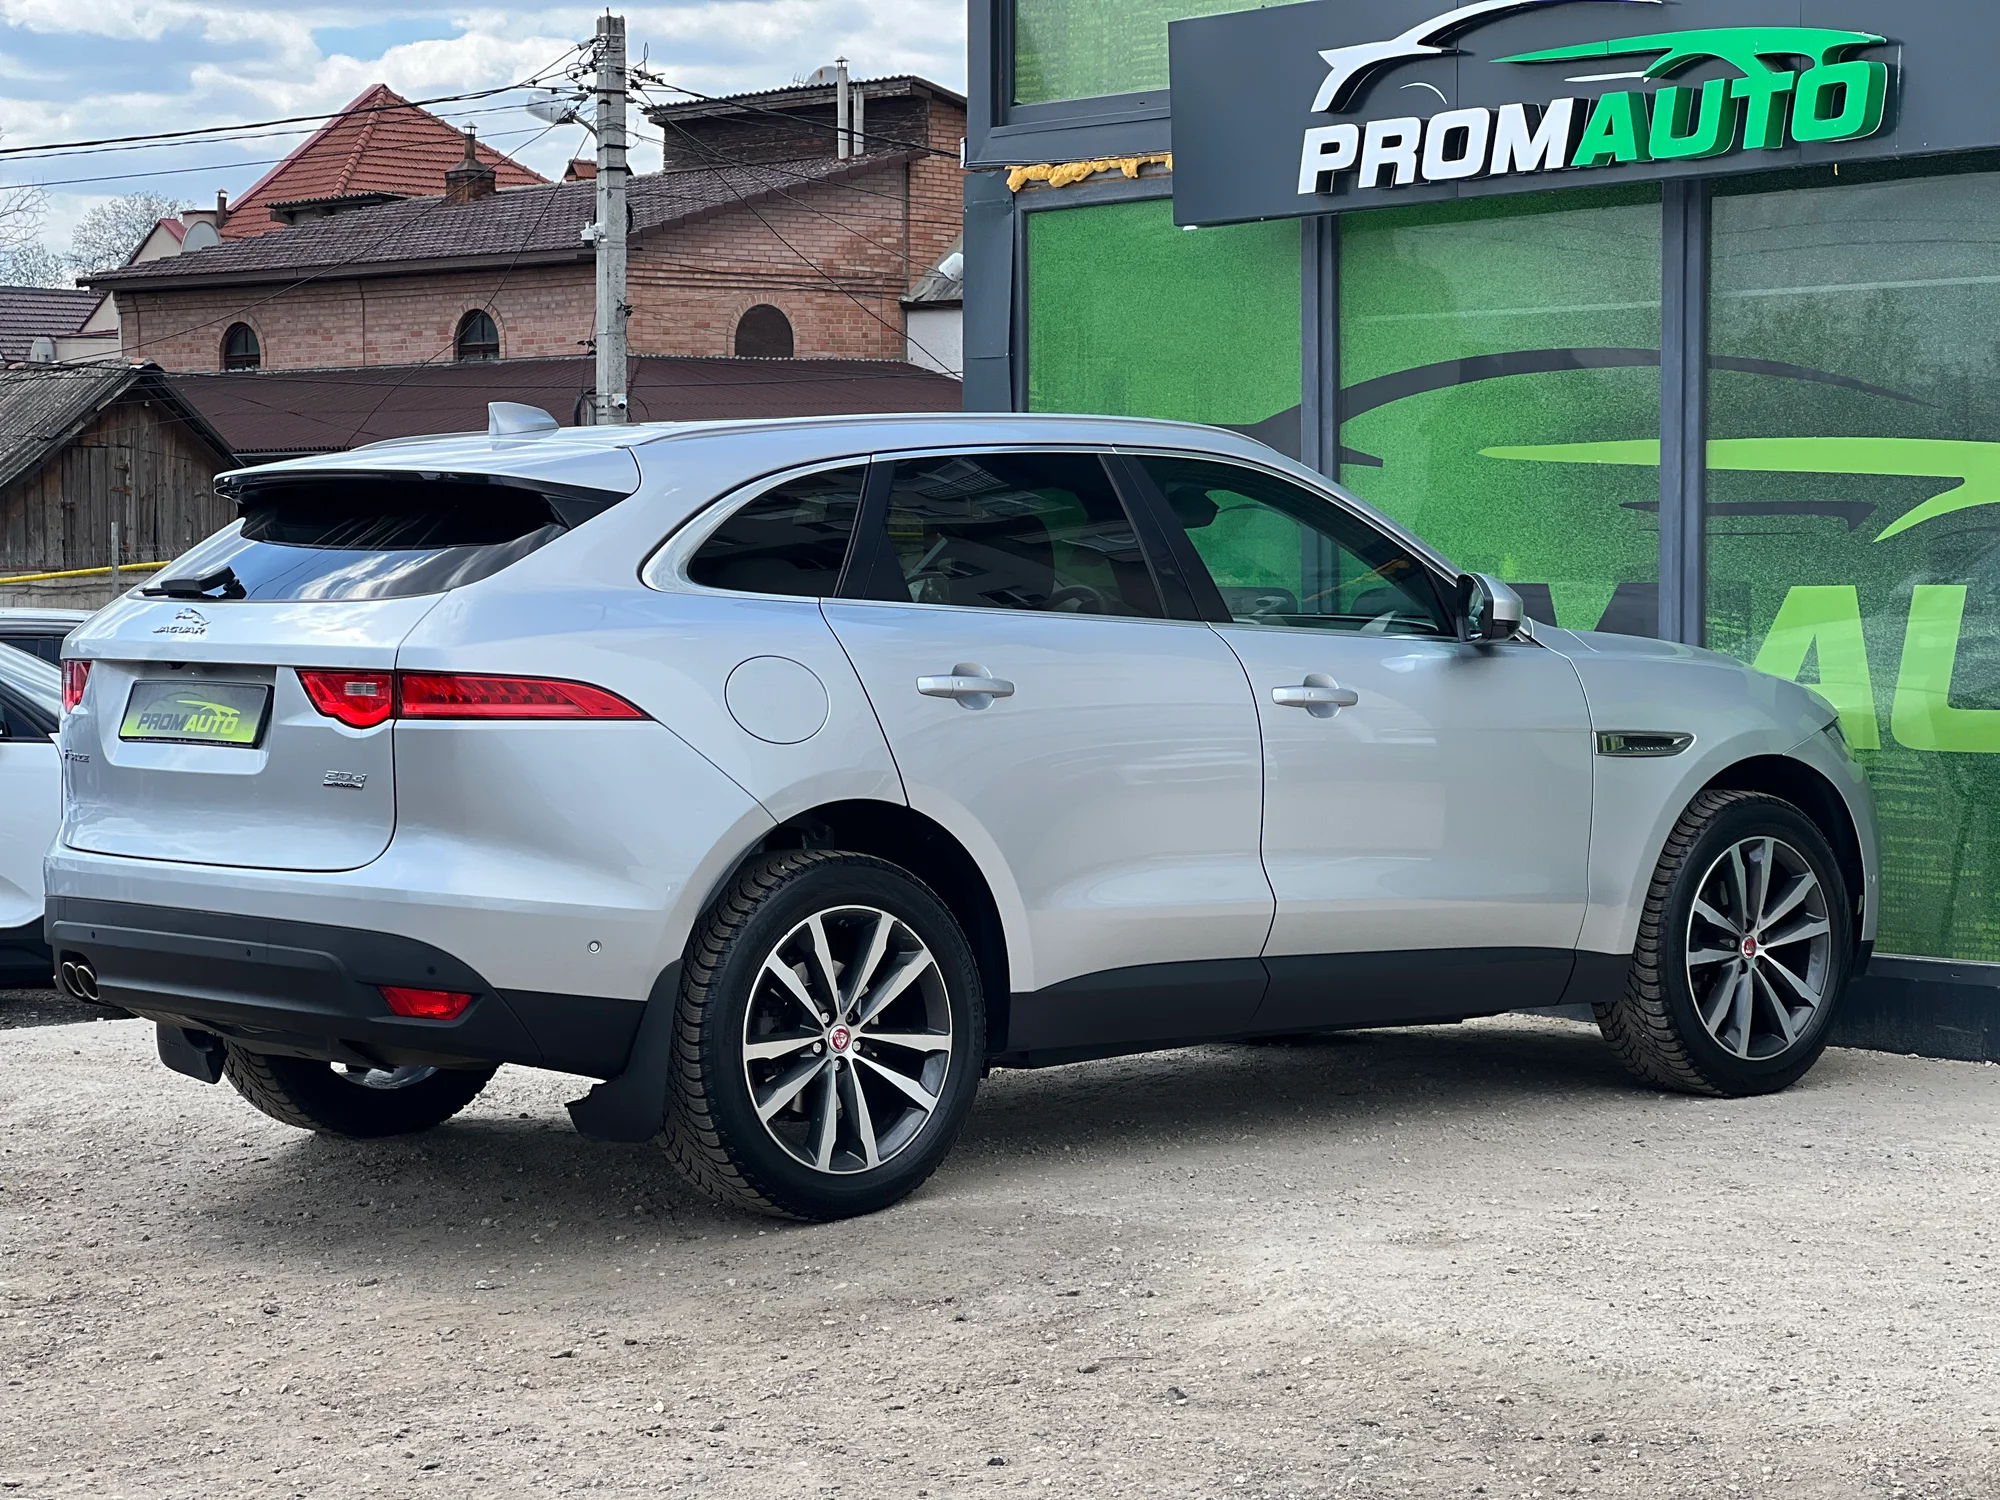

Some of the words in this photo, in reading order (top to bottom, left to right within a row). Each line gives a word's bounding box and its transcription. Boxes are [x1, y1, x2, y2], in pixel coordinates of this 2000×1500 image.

[1298, 58, 1887, 195] PROMAUTO
[152, 625, 207, 635] JAGUAR
[136, 712, 240, 735] PROMAUTO
